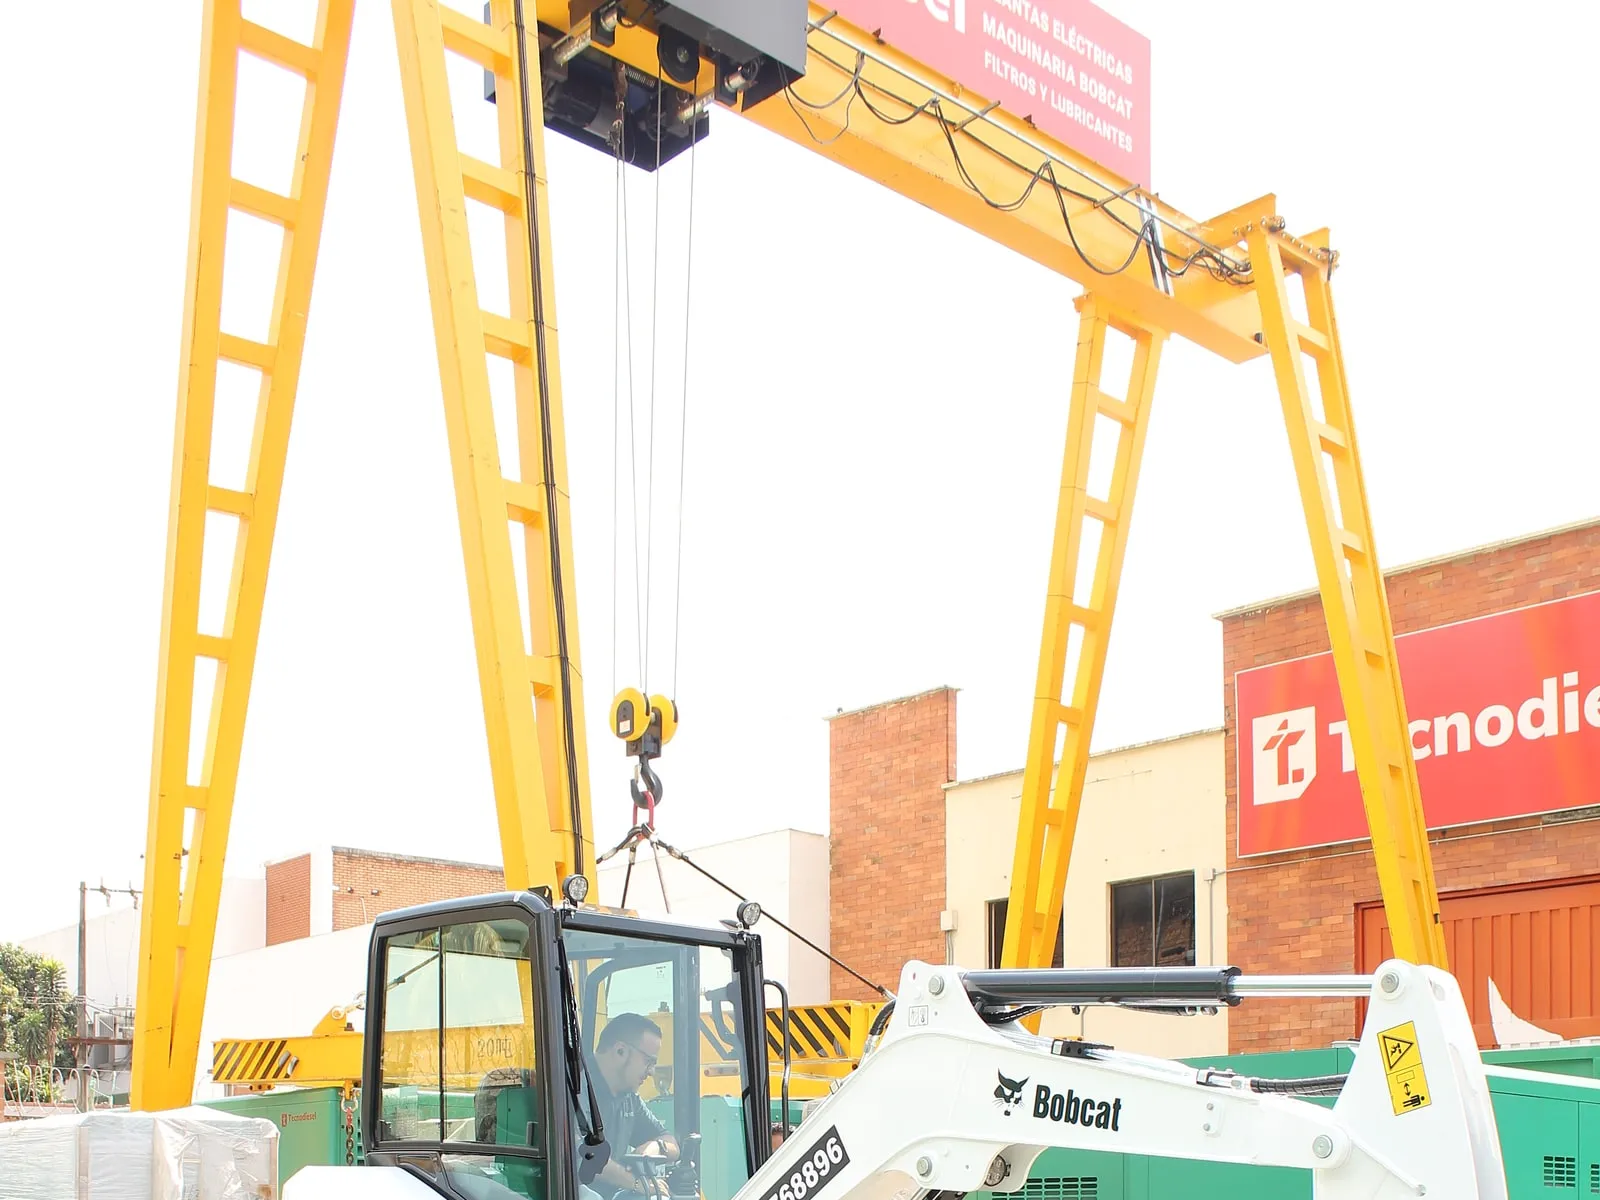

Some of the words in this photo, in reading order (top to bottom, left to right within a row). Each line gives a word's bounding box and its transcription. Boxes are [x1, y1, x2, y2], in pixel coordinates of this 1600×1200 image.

[982, 11, 1077, 88] MAQUINARIA
[1079, 71, 1133, 120] BOBCAT
[992, 0, 1050, 33] ANTAS
[1052, 18, 1133, 85] ELÉCTRICAS
[984, 49, 1037, 97] FILTROS
[1039, 81, 1049, 104] Y
[1050, 88, 1133, 153] LUBRICANTES
[1328, 671, 1600, 773] Tcnodi
[1033, 1084, 1122, 1132] Bobcat
